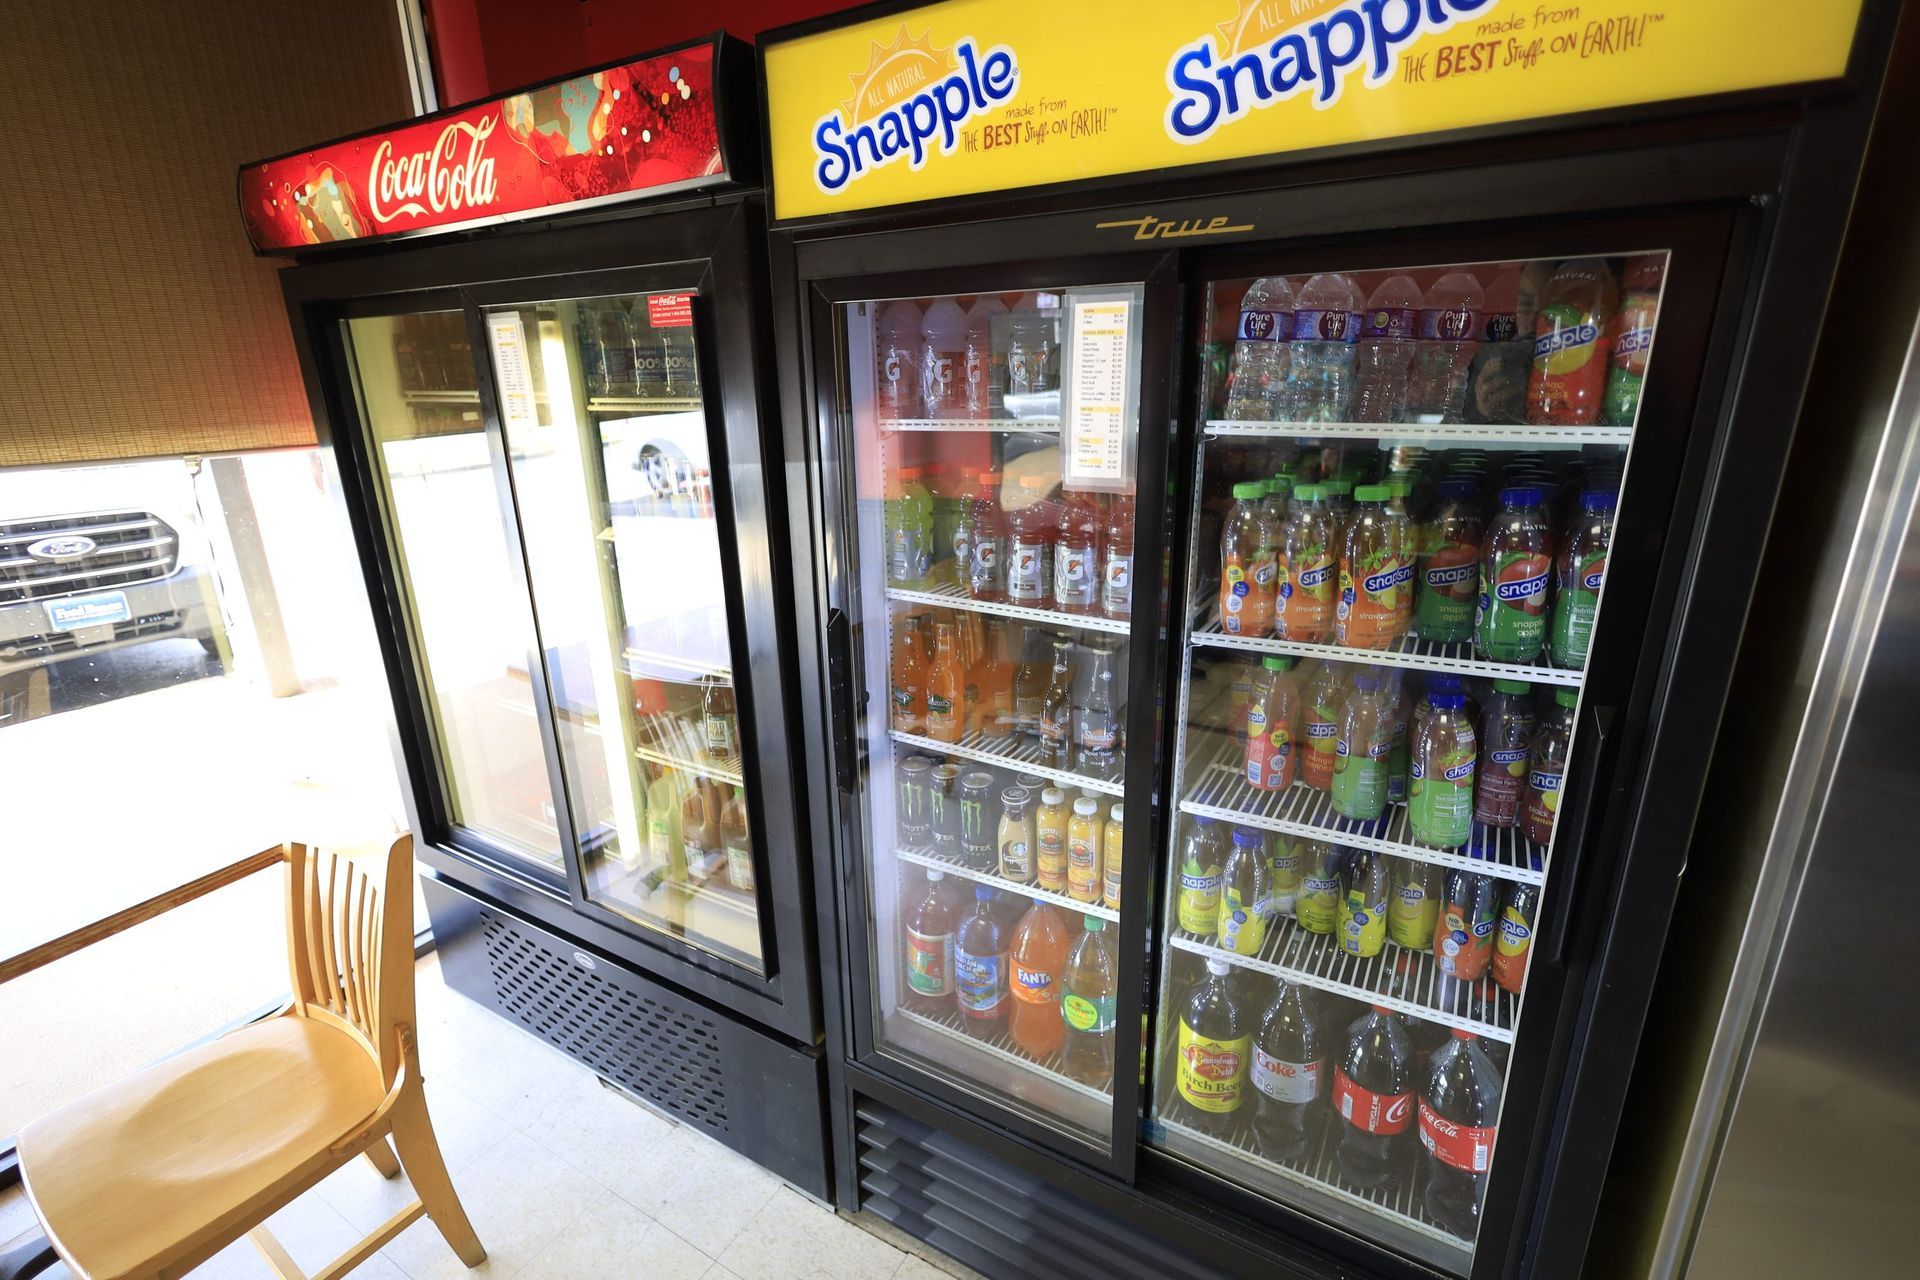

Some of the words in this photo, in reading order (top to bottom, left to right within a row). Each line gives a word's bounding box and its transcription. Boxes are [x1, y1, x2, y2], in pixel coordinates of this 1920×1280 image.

[1258, 3, 1284, 33] ALL
[1476, 13, 1526, 37] made
[1532, 7, 1580, 31] from
[1171, 0, 1487, 137] Snapp
[1402, 53, 1427, 84] THE
[1435, 40, 1502, 80] BEST
[1550, 32, 1577, 54] ON
[866, 88, 885, 108] ALL
[885, 62, 926, 97] NATURAL
[815, 42, 1018, 190] Snapple
[1005, 101, 1035, 119] made
[1039, 97, 1067, 114] from
[962, 131, 978, 153] THE
[983, 122, 1022, 150] BEST
[1052, 120, 1068, 136] ON
[368, 112, 500, 223] Coca-Cola
[1096, 215, 1255, 241] true
[1249, 312, 1271, 321] Pure
[1250, 321, 1267, 331] Life
[1445, 311, 1468, 320] Pure
[1492, 314, 1515, 322] Pure
[1494, 323, 1512, 333] Life
[1535, 325, 1593, 356] napple
[976, 542, 996, 568] G
[1018, 549, 1036, 575] G
[1063, 553, 1084, 580] G
[1106, 560, 1128, 588] G
[1429, 567, 1476, 583] snapp
[1500, 576, 1548, 598] snapp
[1257, 1050, 1297, 1079] Coke
[1182, 1066, 1212, 1091] Birch
[1419, 1104, 1460, 1138] Coca-Cola
